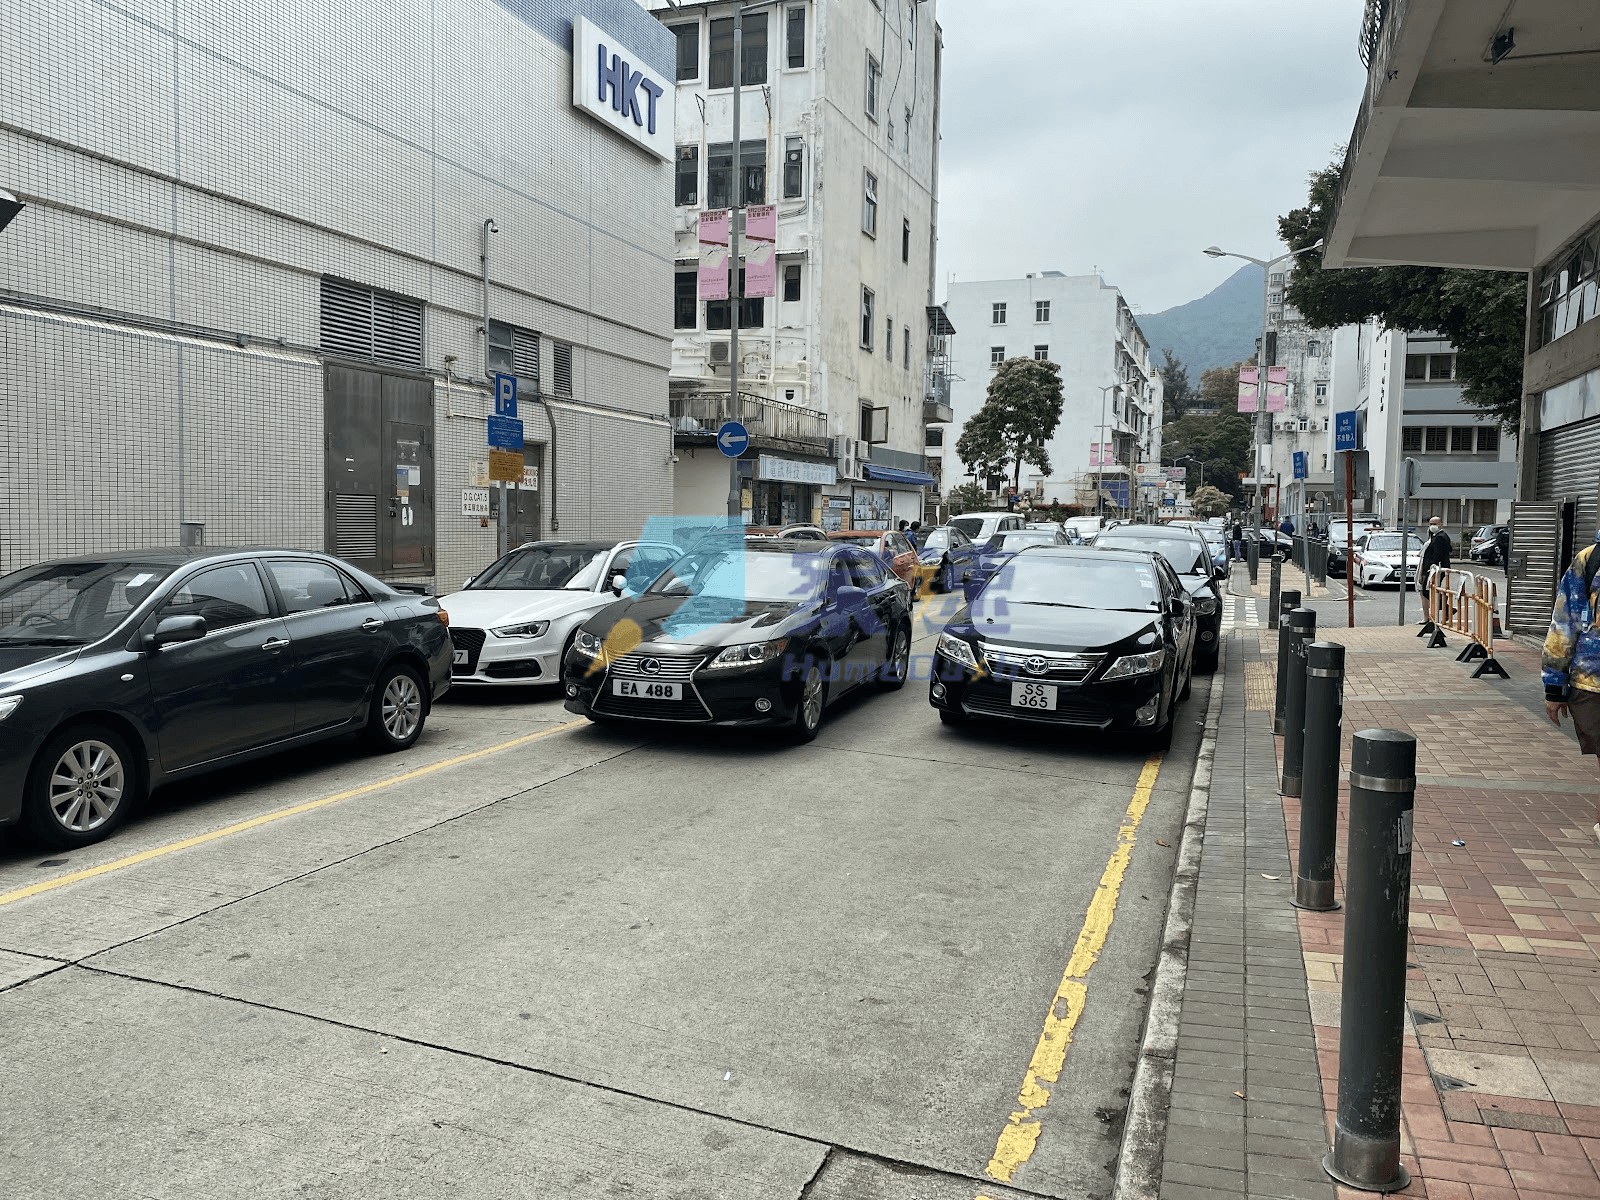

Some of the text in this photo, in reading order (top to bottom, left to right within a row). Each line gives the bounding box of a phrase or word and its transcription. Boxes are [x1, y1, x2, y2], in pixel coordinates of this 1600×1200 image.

[598, 43, 664, 135] HKT
[499, 377, 514, 412] P
[621, 681, 673, 698] EA 488
[1025, 684, 1044, 696] SS
[1018, 694, 1048, 708] 365
